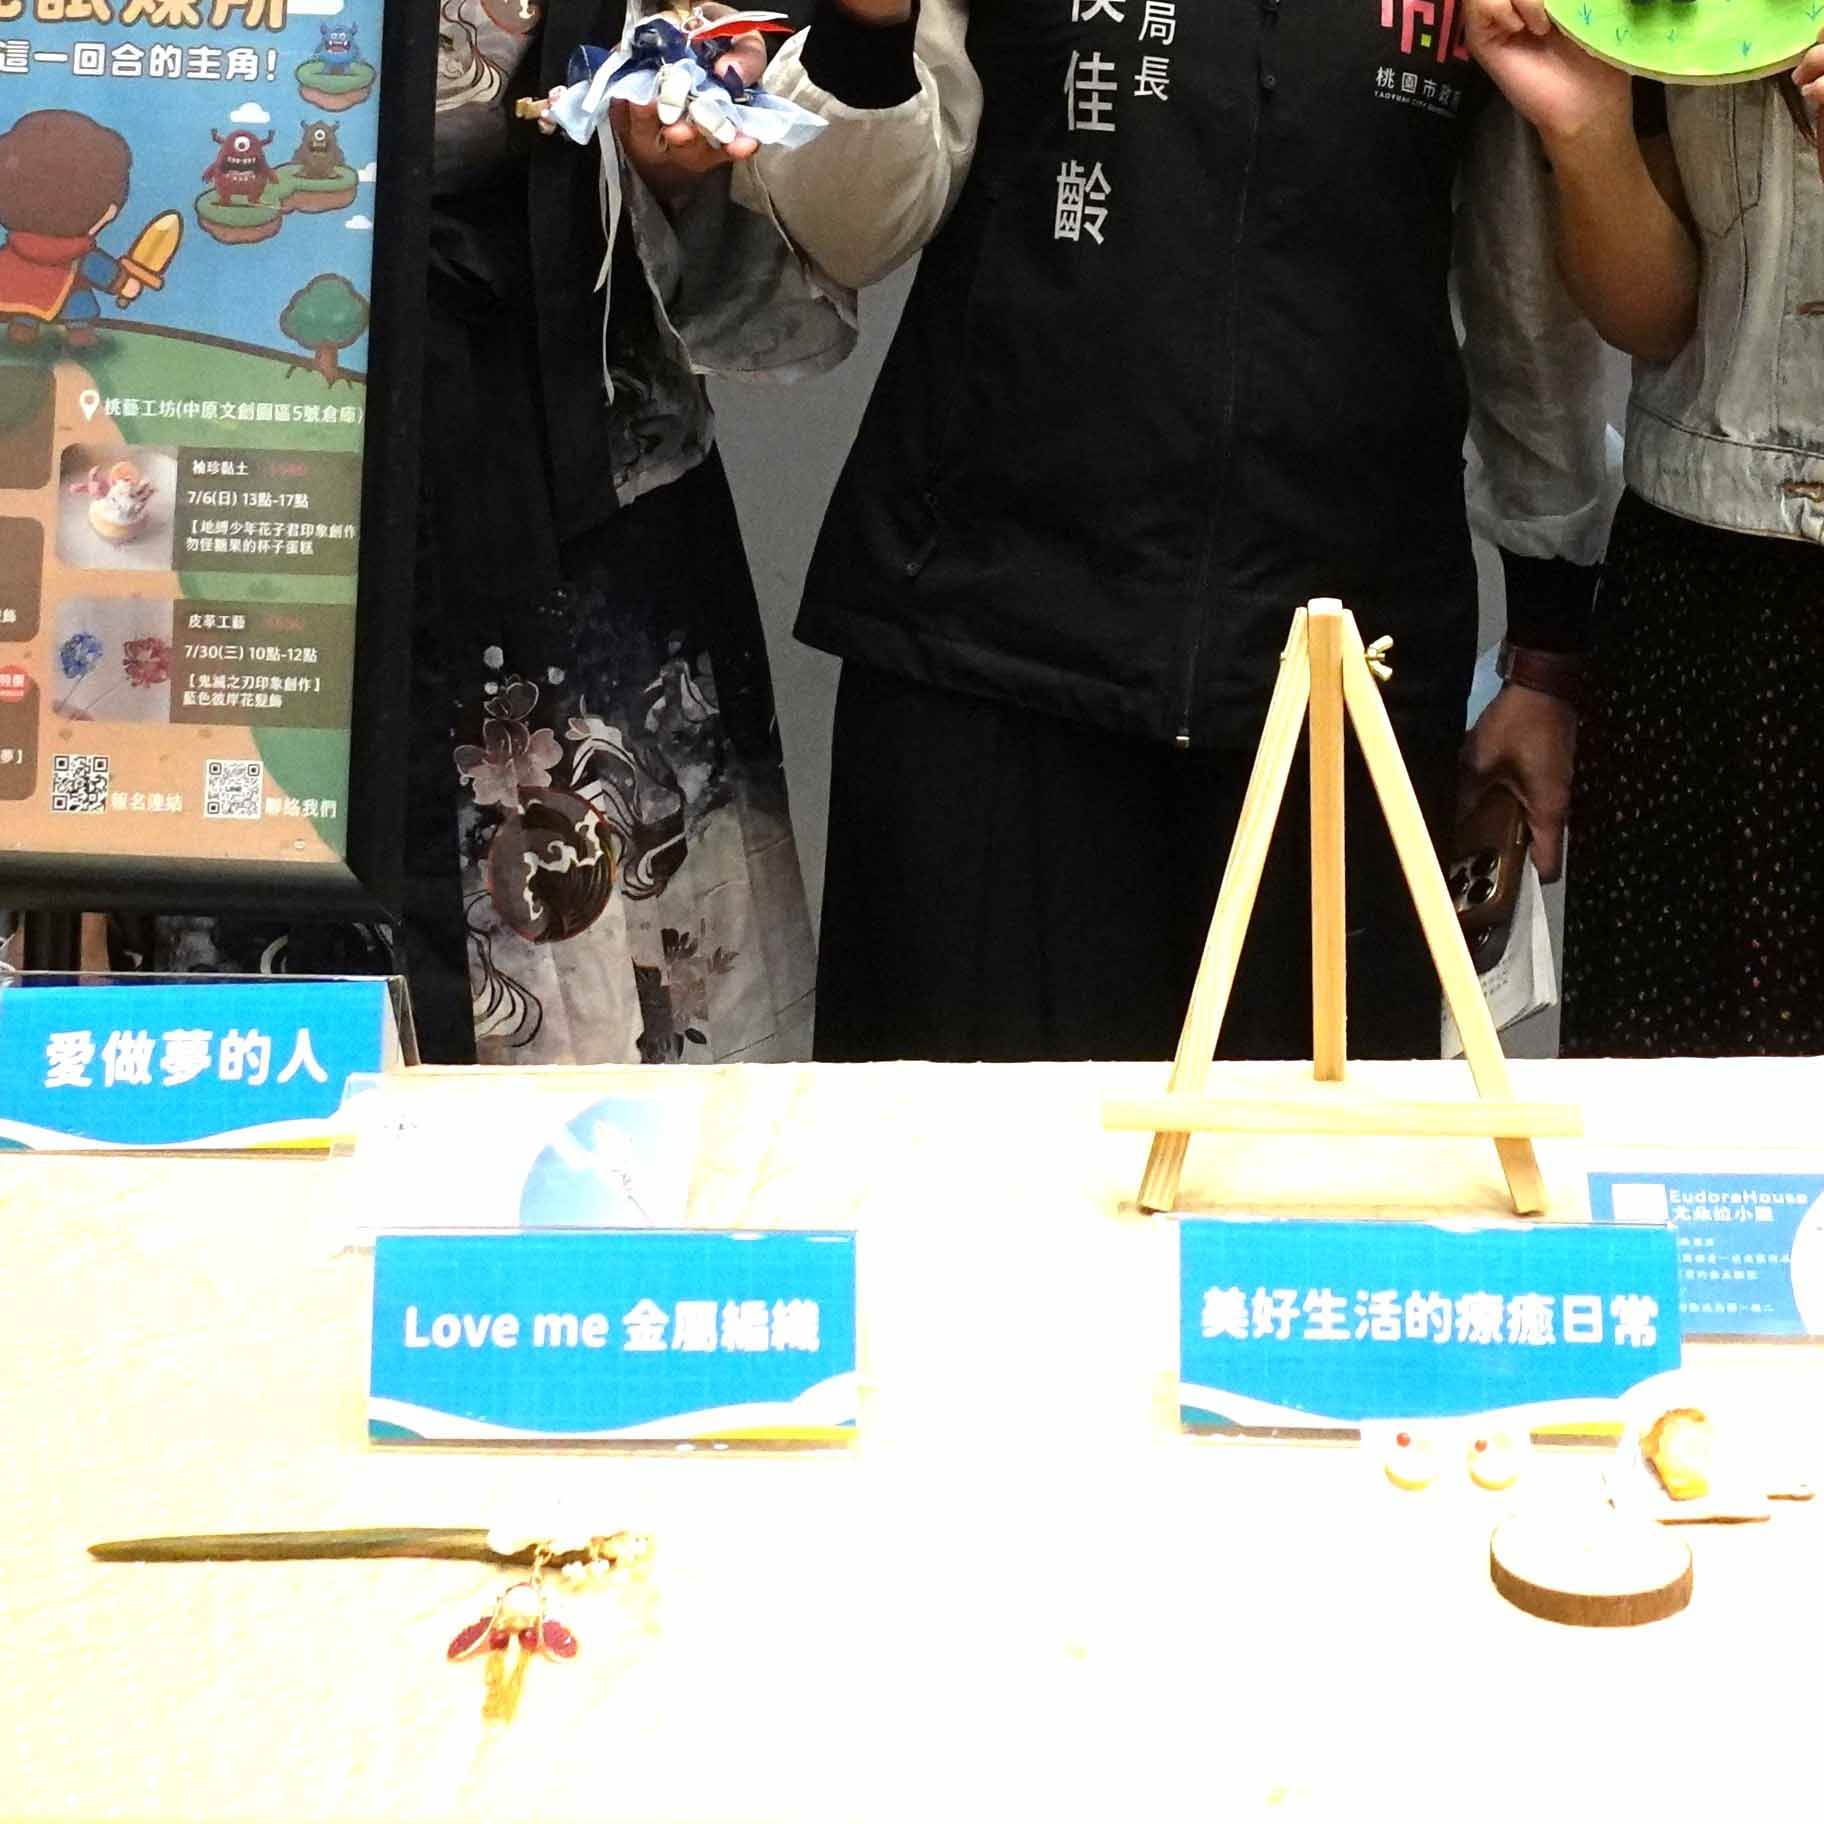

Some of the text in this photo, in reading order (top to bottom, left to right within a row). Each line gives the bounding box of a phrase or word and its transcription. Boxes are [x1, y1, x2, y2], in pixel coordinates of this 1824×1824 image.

[187, 490, 238, 506] 7/6(日)
[184, 645, 245, 661] 7/30(三)
[42, 1027, 328, 1089] 愛做夢的人
[404, 1305, 520, 1349] Love
[532, 1310, 609, 1349] me
[1198, 1285, 1661, 1349] 美好生活的療癒日常
